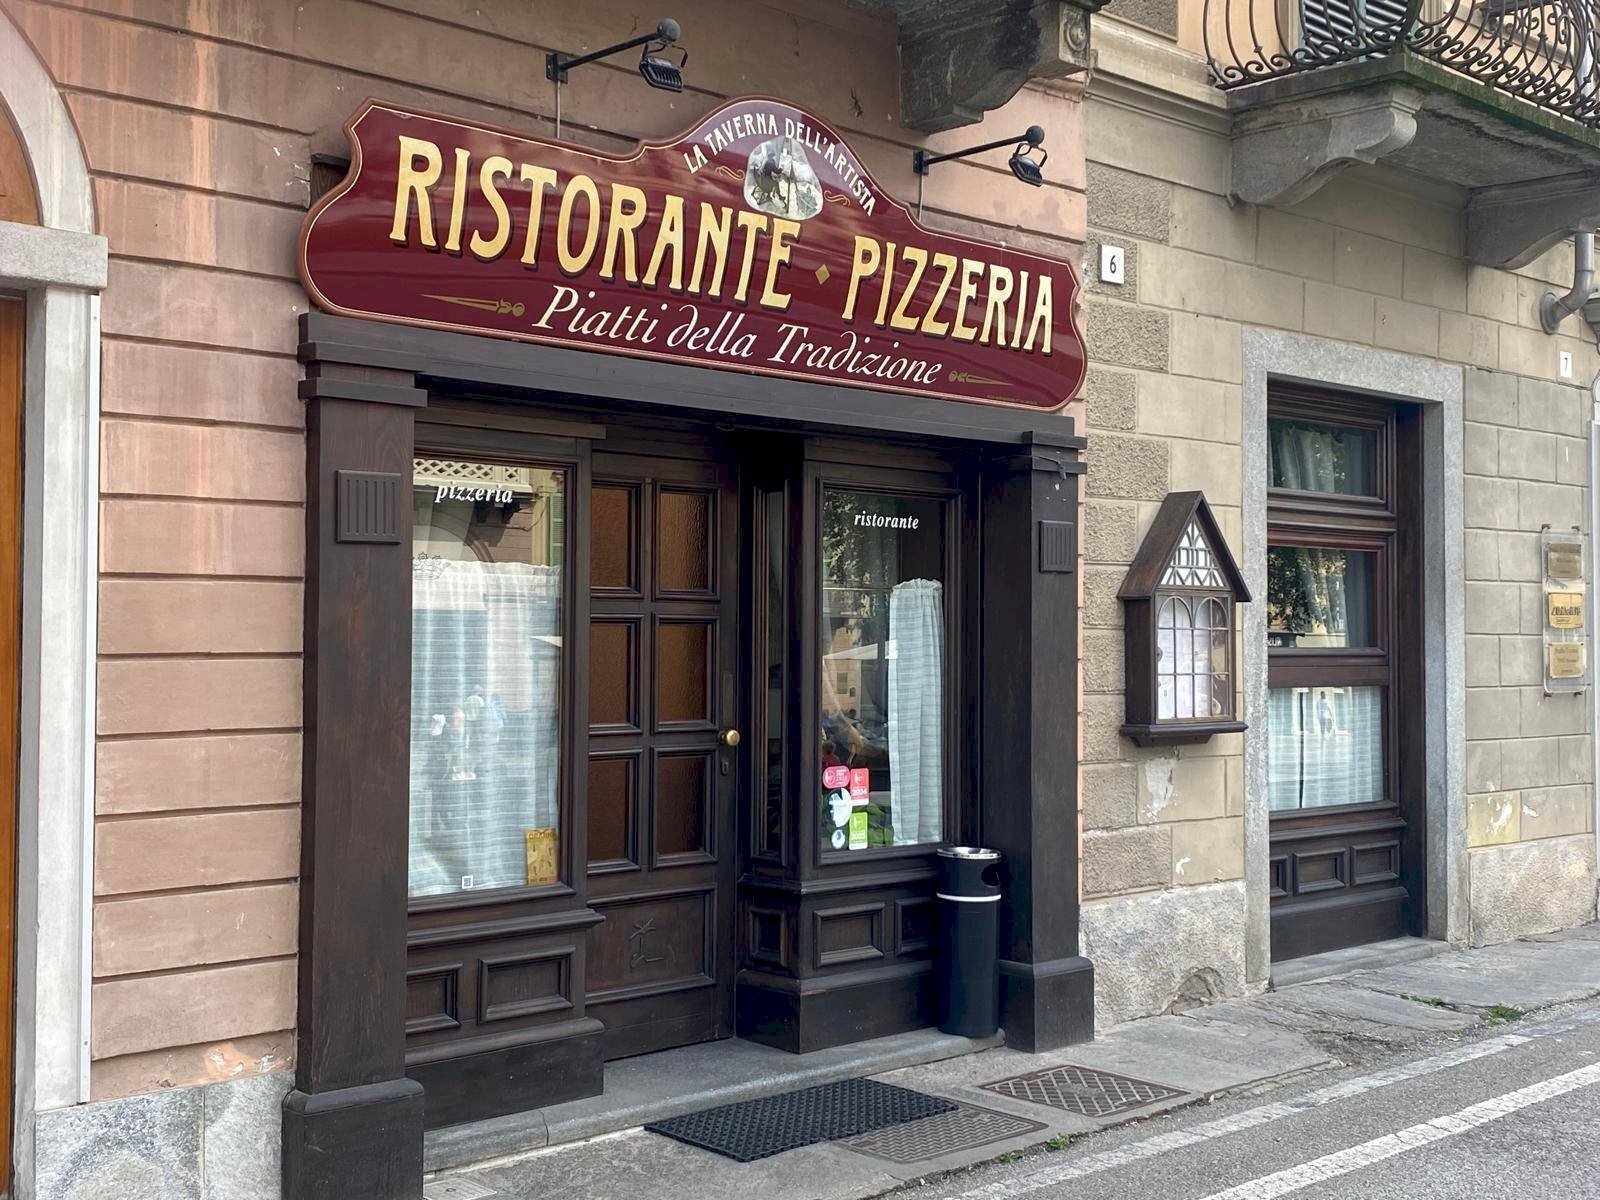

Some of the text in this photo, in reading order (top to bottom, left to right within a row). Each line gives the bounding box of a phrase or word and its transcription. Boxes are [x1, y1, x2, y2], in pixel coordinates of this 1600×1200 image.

[683, 113, 877, 217] LA TAVERNA DELL'ARTISTA
[389, 135, 1053, 354] RISTORANTE PIZZERIA
[1109, 254, 1117, 274] 6
[531, 284, 943, 384] Piatti della Tradizione
[434, 480, 513, 503] pizzeria
[853, 510, 919, 530] ristorante
